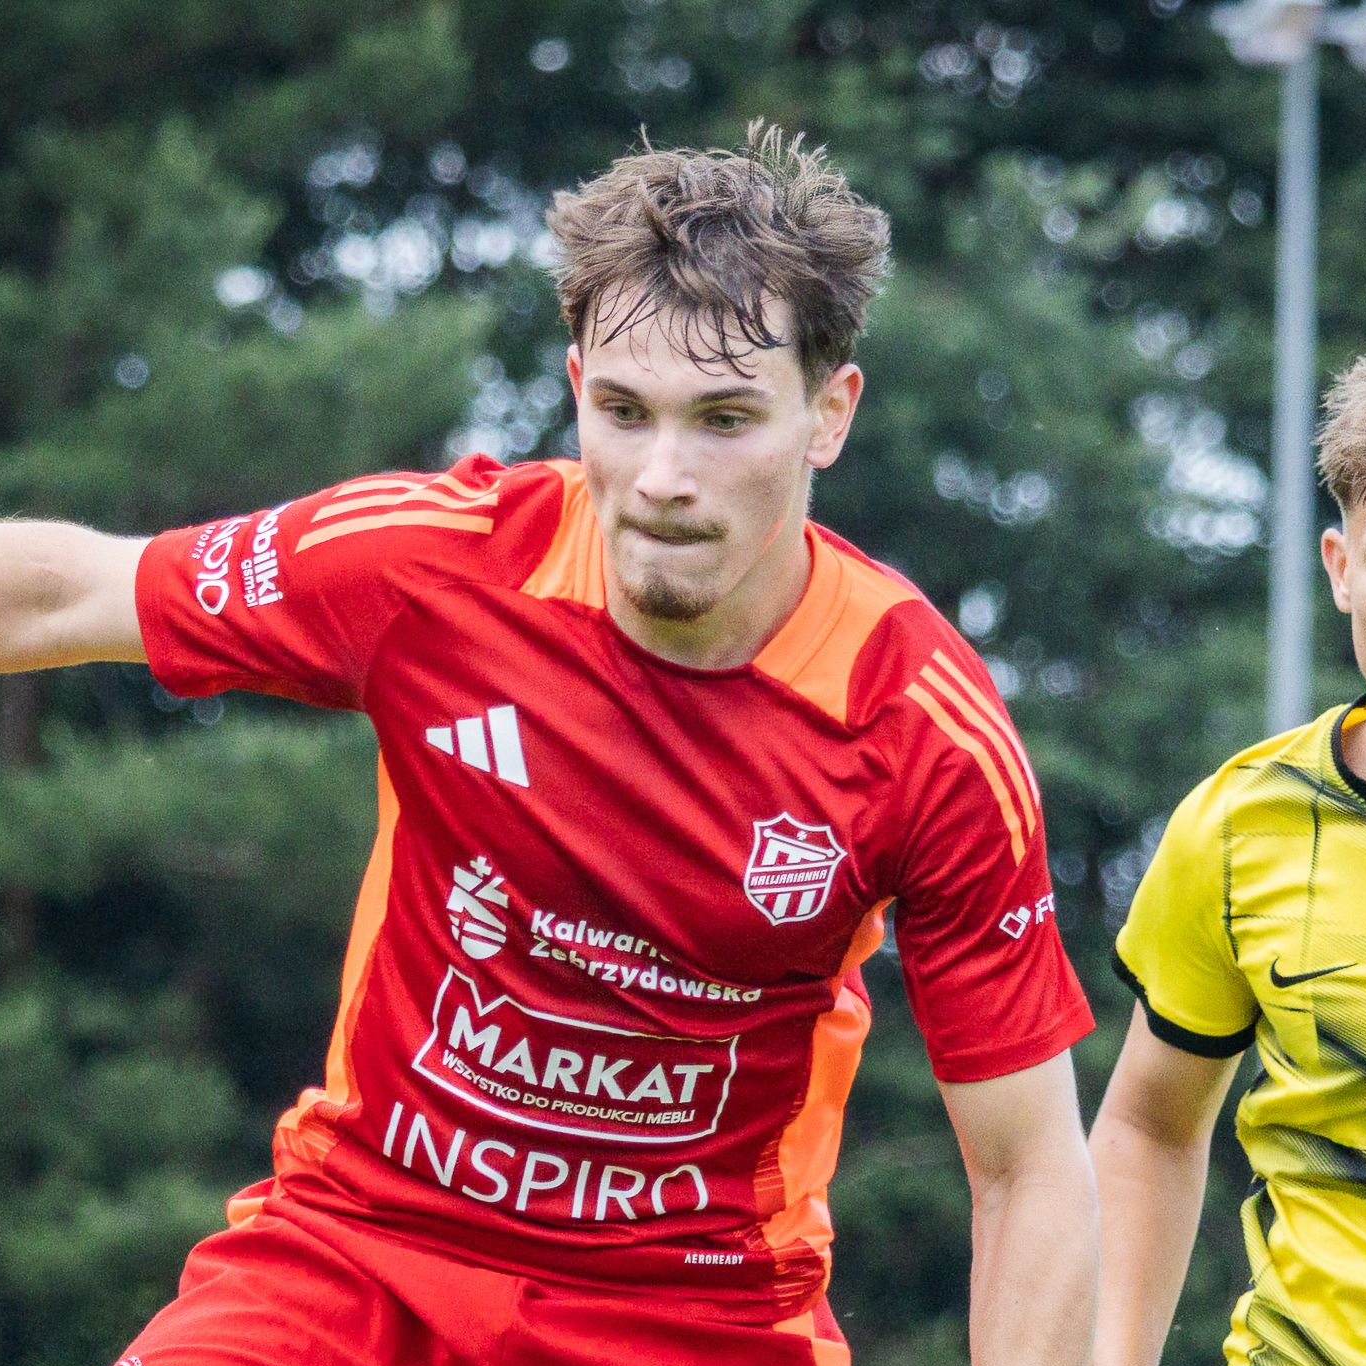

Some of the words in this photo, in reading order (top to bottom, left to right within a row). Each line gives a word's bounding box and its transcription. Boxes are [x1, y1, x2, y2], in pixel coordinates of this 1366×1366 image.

[253, 500, 294, 606] obilki
[441, 1048, 521, 1102] WSZYSTKO
[522, 1092, 550, 1109] DO
[551, 1099, 644, 1124] PRODUKCJI
[645, 1109, 696, 1125] MEBLI
[447, 1005, 715, 1105] MARKAT
[383, 1101, 709, 1222] INSPIRO
[684, 1253, 745, 1266] AEROREADY
